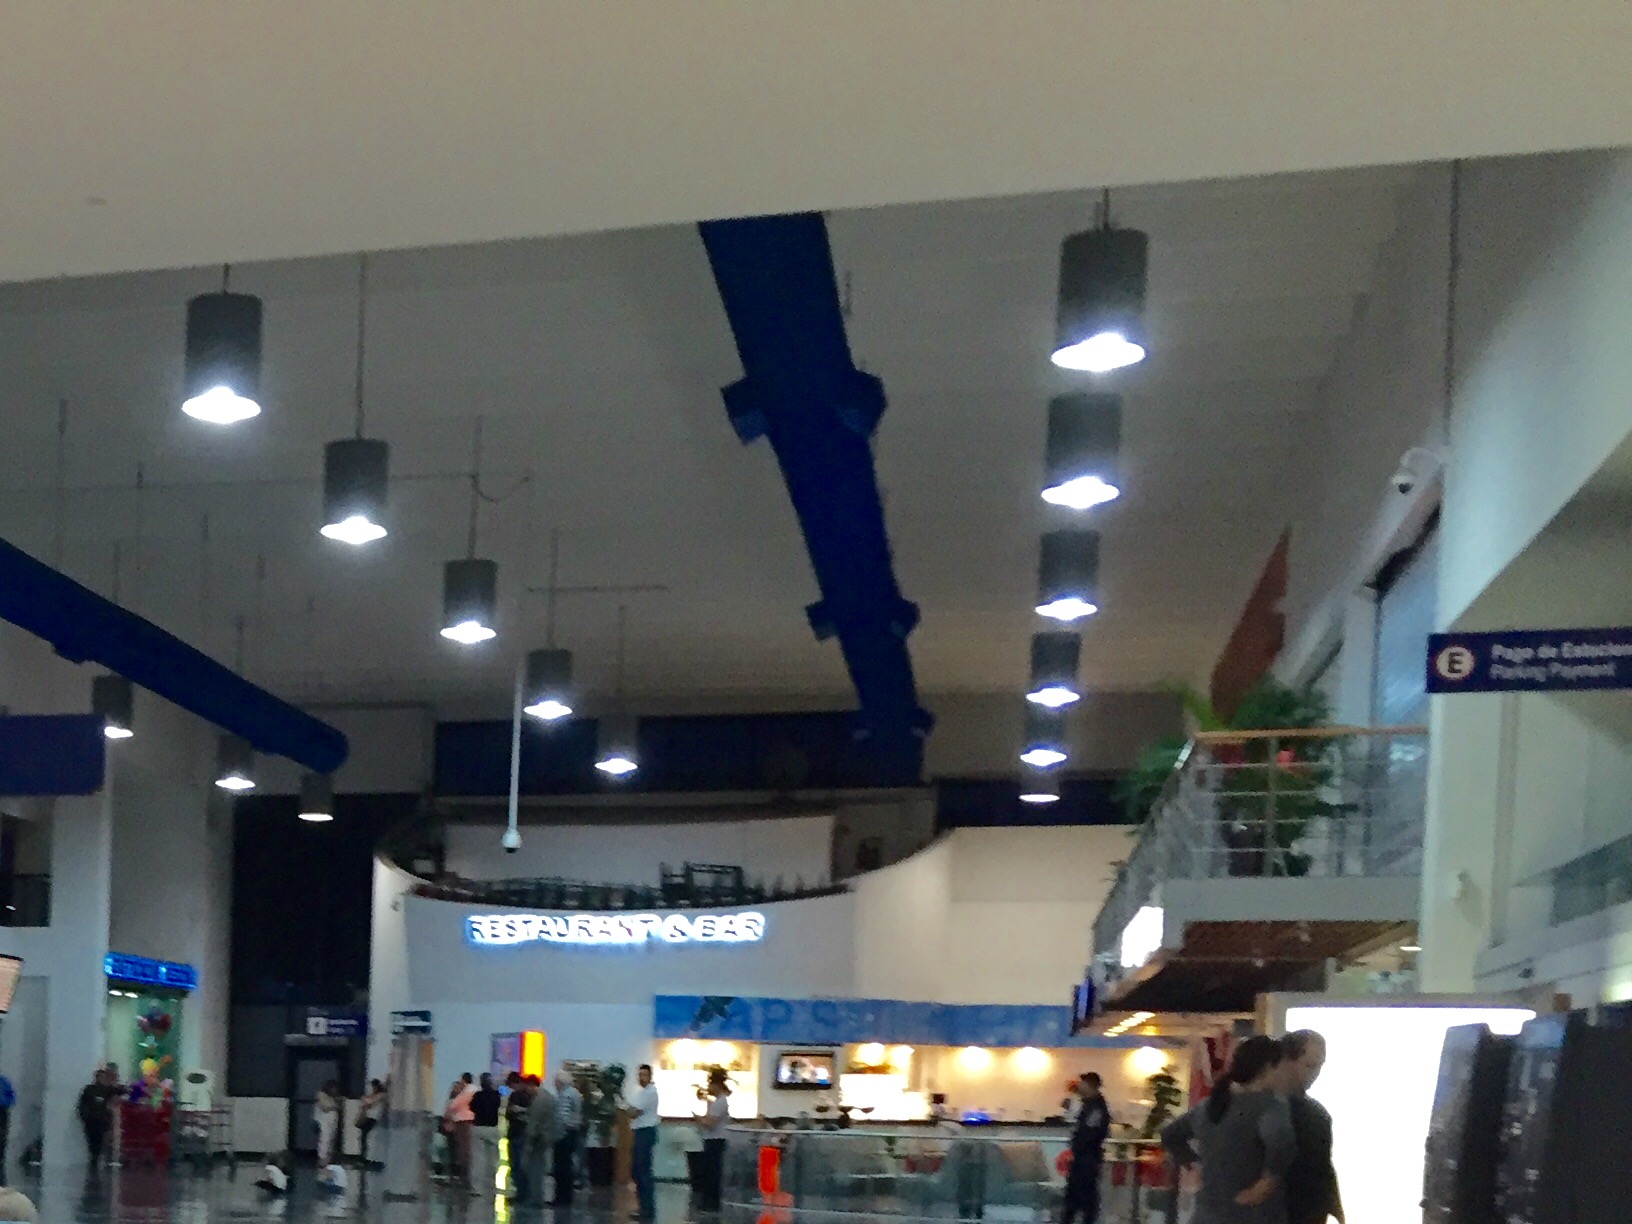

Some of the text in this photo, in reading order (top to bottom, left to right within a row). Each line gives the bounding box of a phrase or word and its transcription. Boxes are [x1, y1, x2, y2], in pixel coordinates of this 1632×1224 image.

[1447, 651, 1464, 674] E
[467, 914, 661, 944] RESTAURANT
[694, 911, 765, 941] BAR
